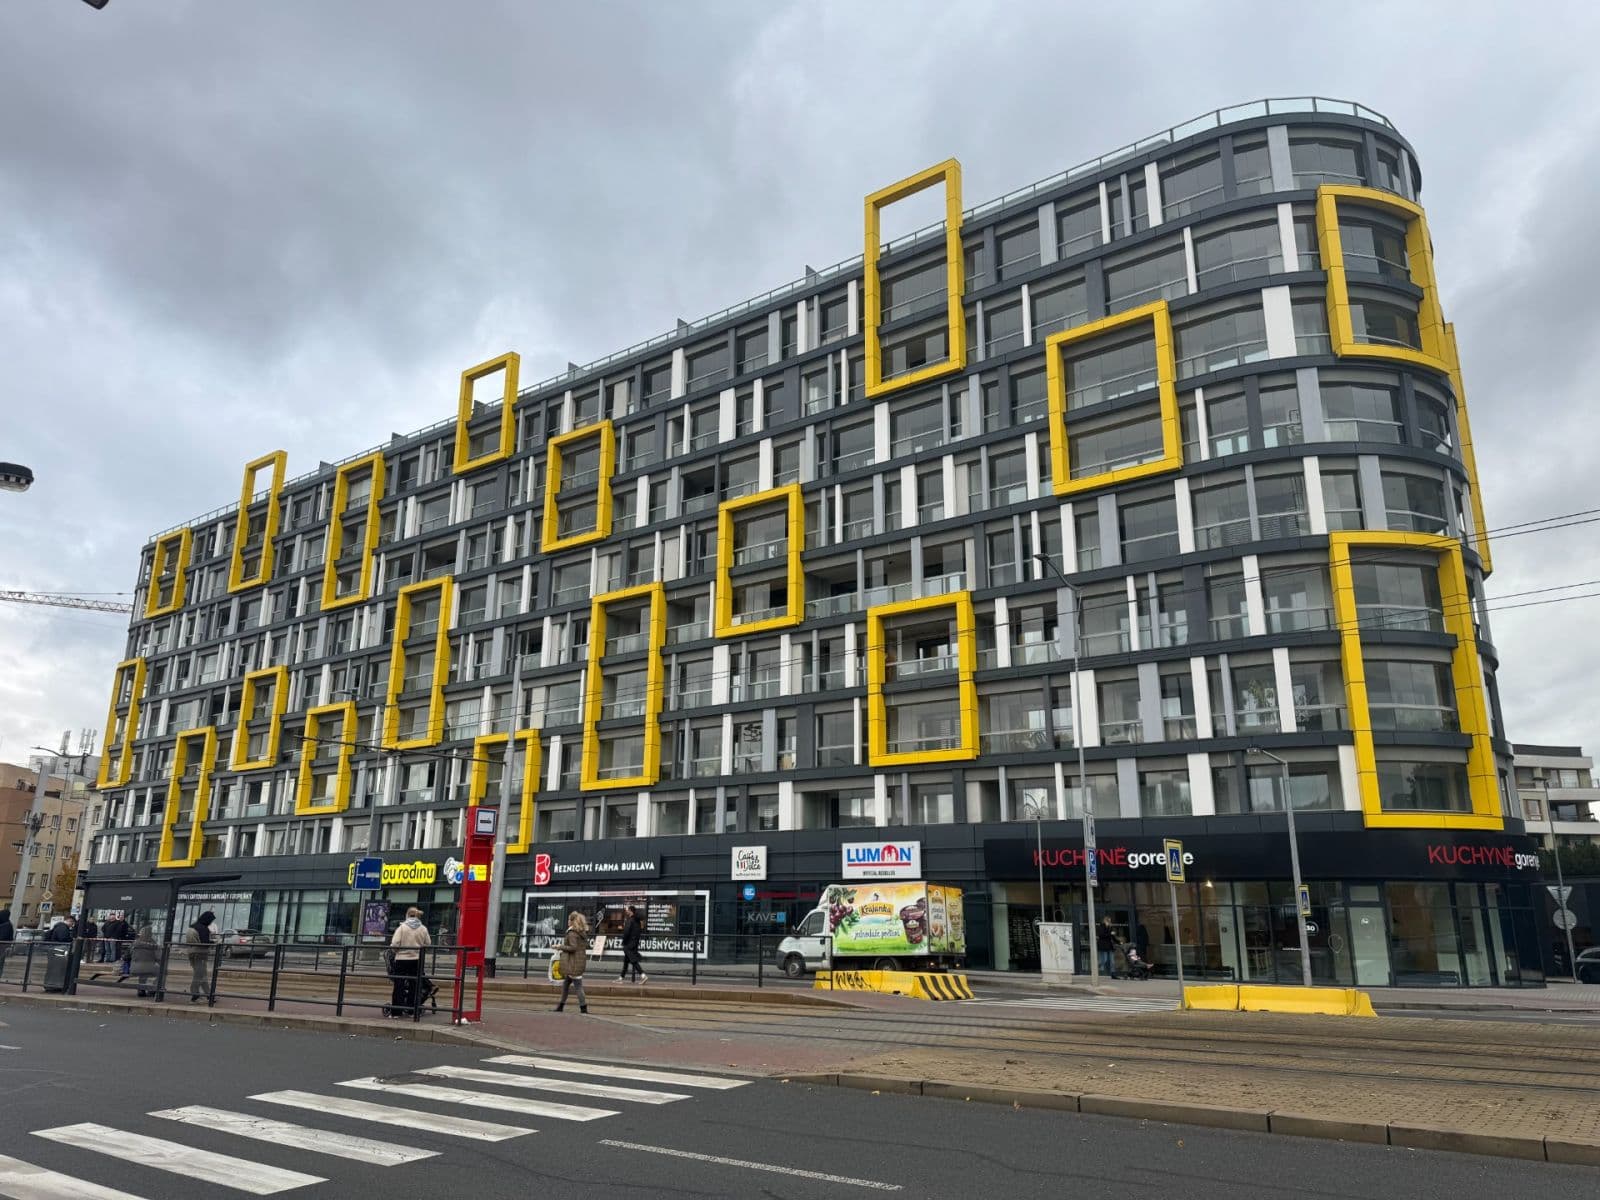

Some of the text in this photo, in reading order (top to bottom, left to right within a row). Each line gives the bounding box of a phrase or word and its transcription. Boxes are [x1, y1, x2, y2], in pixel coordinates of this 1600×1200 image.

[1033, 846, 1194, 869] KUCHNĚ goree
[398, 864, 434, 880] rodinu
[553, 861, 655, 873] ŘEZNICTVÍ FARMA BUBLAVA
[638, 937, 681, 951] RUŠNÝCH
